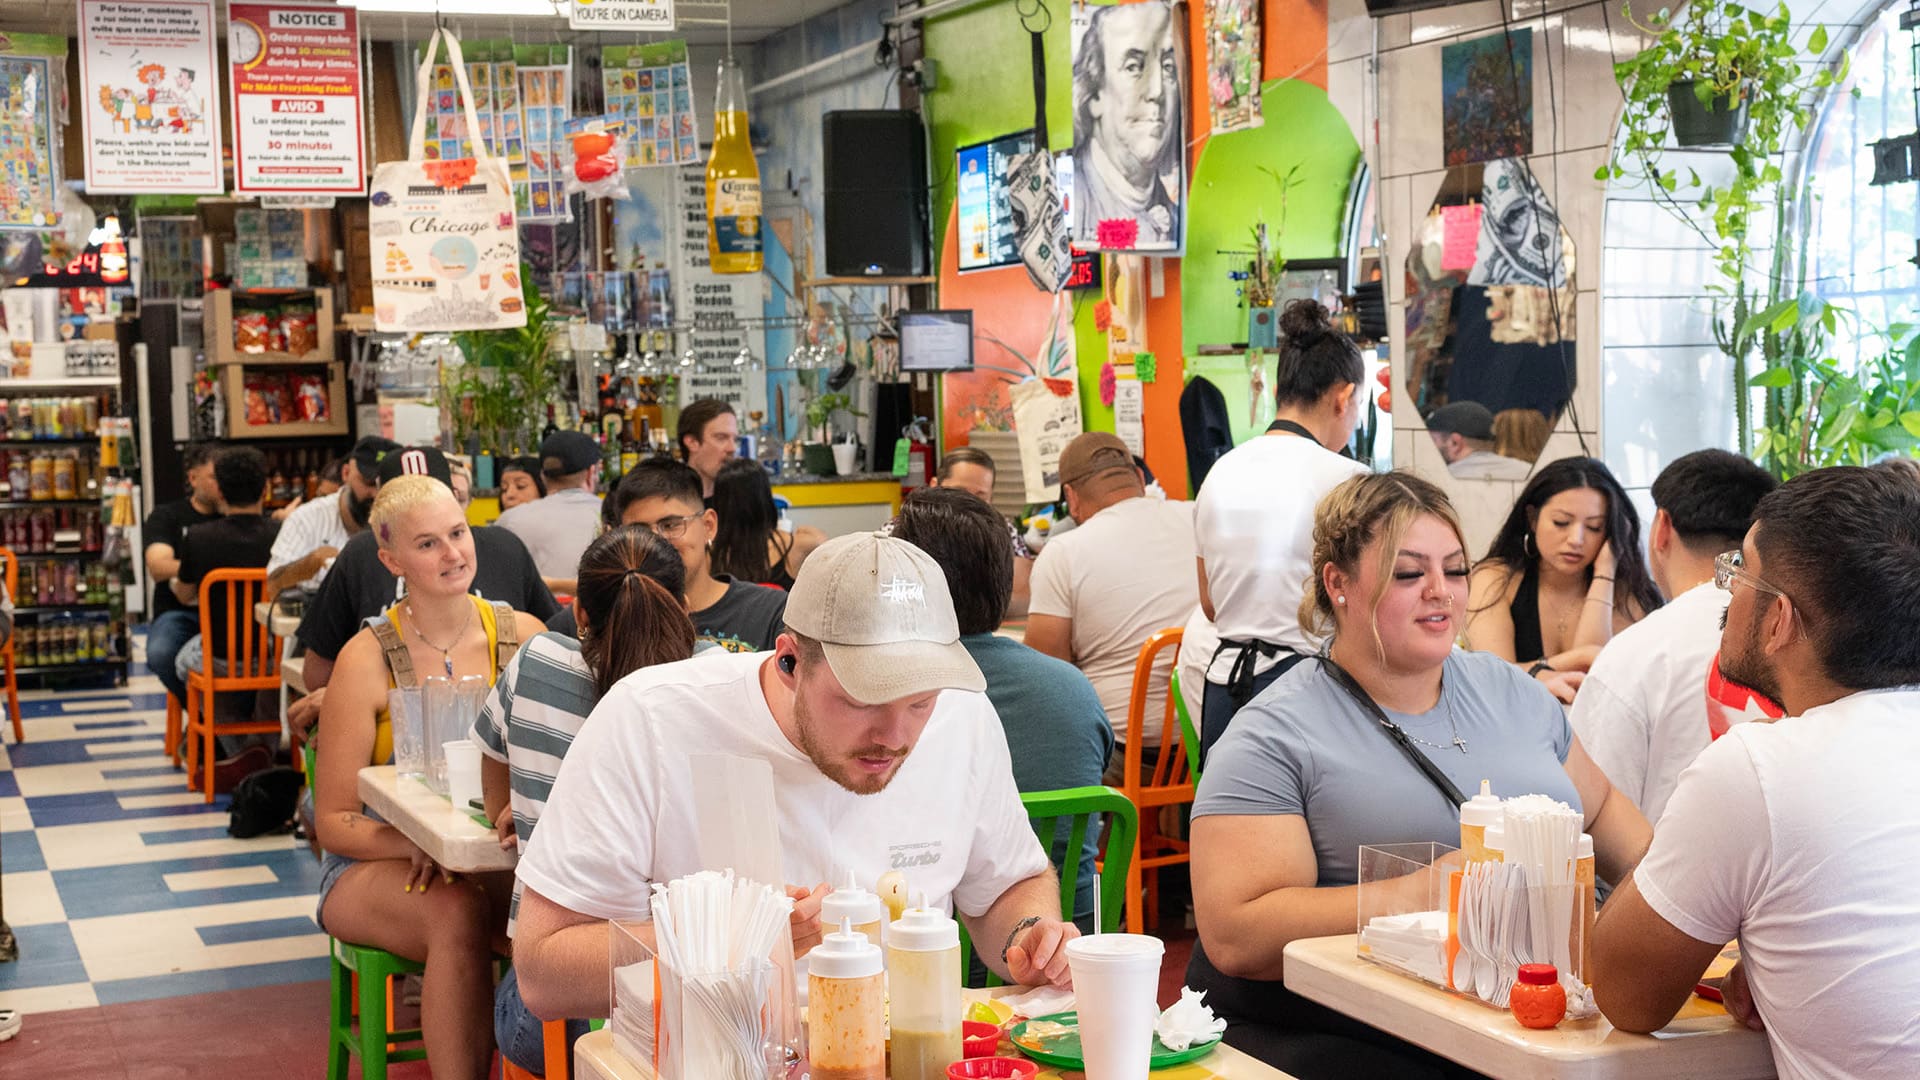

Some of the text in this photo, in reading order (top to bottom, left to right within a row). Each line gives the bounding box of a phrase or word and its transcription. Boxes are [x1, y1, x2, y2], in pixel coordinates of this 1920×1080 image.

[100, 4, 193, 16] Por favor, mantenga
[576, 7, 668, 20] YOU'RE ON CAMERA
[278, 14, 337, 26] NOTICE
[115, 26, 132, 34] que
[134, 26, 158, 34] esten
[270, 32, 351, 45] Orders may take
[270, 47, 351, 56] up to 30 minutes
[267, 57, 356, 70] during busy times.
[247, 73, 269, 81] Thank
[270, 75, 284, 83] you
[285, 74, 296, 82] for
[296, 75, 314, 83] your
[255, 83, 278, 91] Make
[279, 84, 324, 94] Everything
[325, 84, 353, 92] Fresh!
[278, 101, 318, 112] AVISO
[252, 116, 346, 127] Las ordenes pueden
[303, 129, 330, 137] hasta
[95, 138, 126, 147] Please,
[268, 141, 333, 150] 30 minutos
[409, 216, 490, 236] Chicago
[694, 284, 731, 293] Corona
